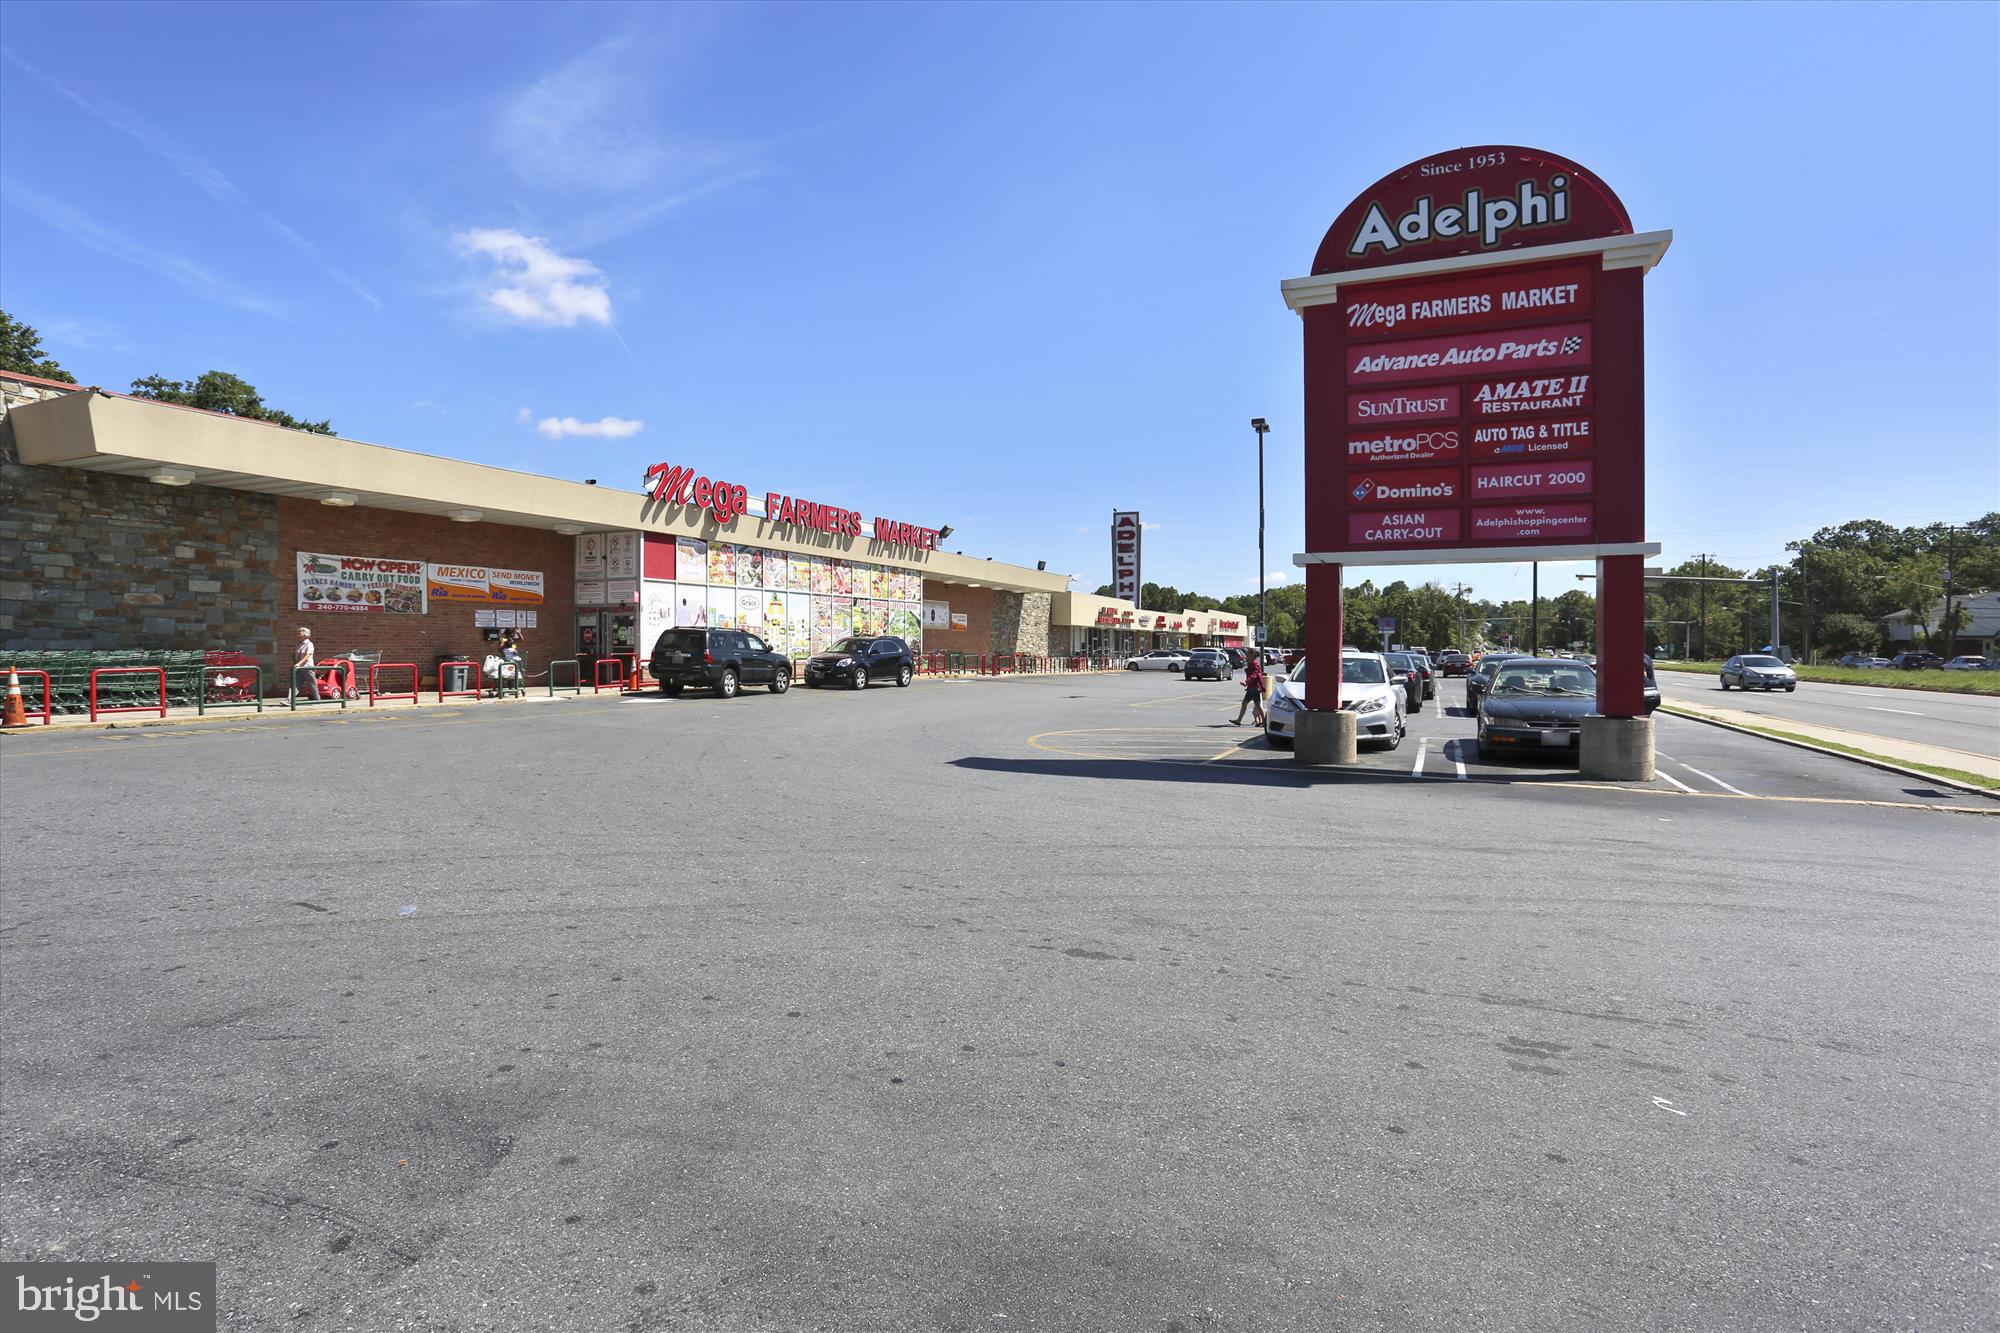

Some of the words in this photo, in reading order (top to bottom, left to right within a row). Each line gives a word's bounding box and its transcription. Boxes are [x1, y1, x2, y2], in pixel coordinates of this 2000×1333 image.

[1420, 160, 1462, 178] Since
[1468, 152, 1506, 171] 1953
[1349, 175, 1568, 255] Adelphi
[1347, 302, 1406, 328] Mega
[1411, 294, 1492, 320] FARMERS
[1501, 284, 1579, 311] MARKET
[1353, 353, 1440, 374] Advance
[1440, 345, 1496, 366] Auto
[1497, 338, 1559, 361] Parts
[1473, 378, 1565, 402] AMATE
[1568, 375, 1589, 394] II
[1482, 395, 1583, 414] RESTAURANT
[1474, 428, 1508, 443] AUTO
[1511, 425, 1535, 440] TAG
[1538, 424, 1549, 438] &
[1552, 422, 1589, 437] TITLE
[1348, 431, 1458, 455] metroPCS
[1528, 441, 1568, 452] Licensed
[1410, 451, 1435, 459] Dealer
[1477, 474, 1542, 489] HAIRCUT
[1548, 472, 1586, 485] 2000
[1376, 482, 1453, 499] Domino's
[647, 462, 748, 523] Mega
[766, 492, 862, 537] FARMERS
[874, 517, 940, 550] MARKET
[1516, 507, 1545, 515] www.
[1382, 513, 1425, 526] ASIAN
[1476, 515, 1587, 527] Adelphishoppingcenter
[1365, 527, 1443, 541] CARRY-OUT
[1516, 527, 1540, 536] .com
[340, 558, 376, 571] NOW
[377, 560, 420, 575] OPEN!
[437, 566, 486, 580] MEXICO
[341, 571, 375, 582] CARRY
[377, 573, 395, 583] OUT
[397, 574, 420, 585] FOOD
[492, 571, 512, 580] SEND
[513, 573, 540, 581] MONEY
